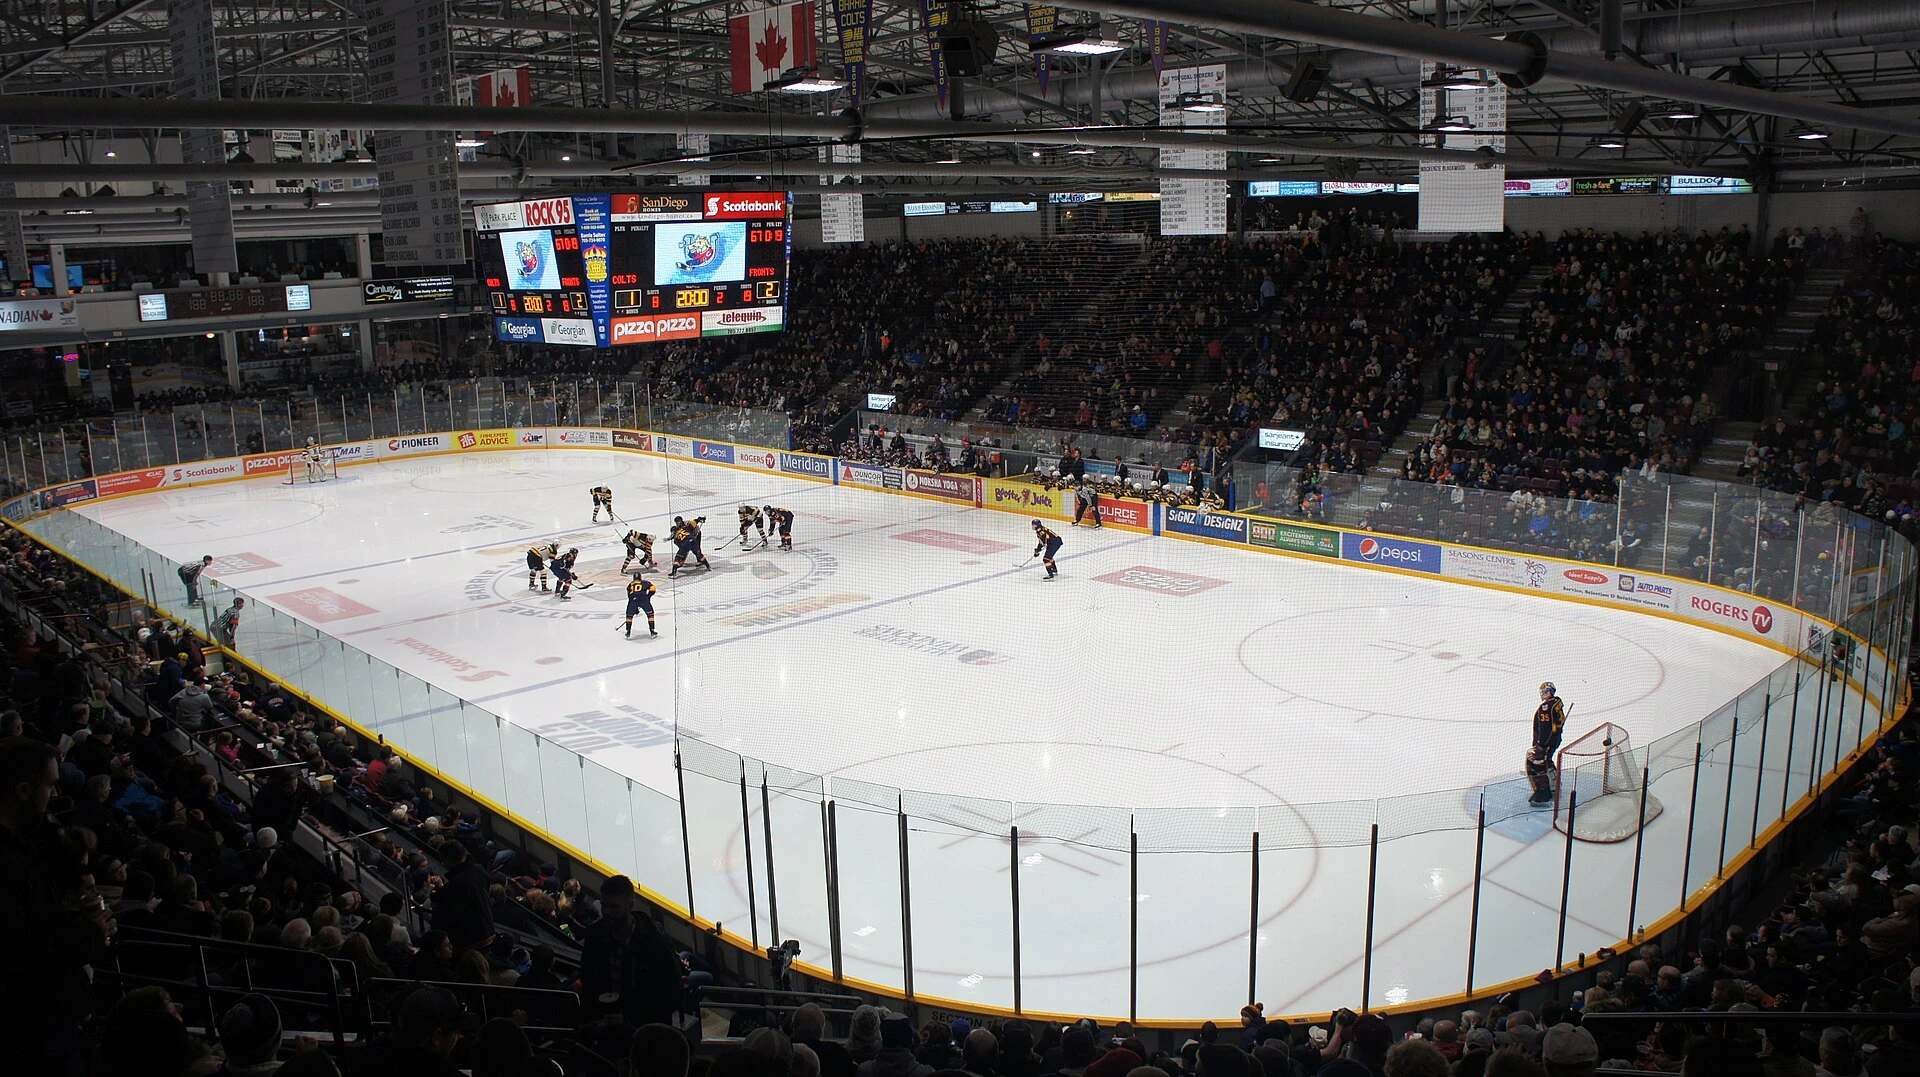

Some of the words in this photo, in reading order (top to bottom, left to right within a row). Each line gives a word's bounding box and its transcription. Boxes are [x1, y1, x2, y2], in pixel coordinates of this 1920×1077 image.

[841, 11, 865, 26] COLTS
[1031, 16, 1054, 26] EASTERN
[845, 47, 863, 56] CENTRAL
[845, 55, 863, 64] DIVISION
[642, 196, 689, 211] SanDiego
[723, 199, 782, 212] Scotiabank
[489, 213, 501, 221] PARK
[502, 212, 517, 221] PLACE
[525, 202, 556, 226] ROCK
[556, 199, 571, 224] 95
[748, 268, 775, 277] FRONTS
[612, 274, 637, 285] COLTS
[365, 284, 395, 295] Century
[393, 289, 402, 300] 21
[765, 282, 773, 297] 2
[576, 293, 583, 308] 2
[677, 290, 708, 306] 20:00
[716, 292, 724, 304] 2
[722, 311, 762, 326] telequip
[507, 321, 536, 338] Georgian
[558, 325, 586, 338] Georgian
[614, 320, 655, 341] pizza
[656, 317, 696, 337] pizza
[401, 437, 439, 448] PIONEER
[480, 437, 509, 446] ADVICE
[1264, 432, 1295, 440] sarjeant
[708, 448, 727, 458] pepsi
[740, 453, 765, 464] ROGERS
[246, 456, 276, 472] pizza
[782, 453, 827, 473] Meridian
[186, 465, 235, 478] Scotiabank
[854, 471, 882, 480] DUNCOR
[919, 476, 943, 488] MOKSHA
[943, 478, 958, 490] YOGA
[994, 487, 1022, 503] Booster
[1031, 492, 1052, 508] Juice
[1098, 505, 1137, 519] OURCE
[1280, 530, 1315, 540] EXCITEMENT
[1381, 545, 1422, 563] pepsi
[1448, 550, 1484, 560] SEASONS
[1486, 555, 1516, 565] CENTRE
[1583, 574, 1603, 582] Supply
[1638, 582, 1654, 591] AUTO
[1654, 584, 1673, 595] PARTS
[1691, 596, 1749, 622] ROGERS
[1753, 612, 1772, 628] TV
[399, 636, 481, 671] Scotiabank
